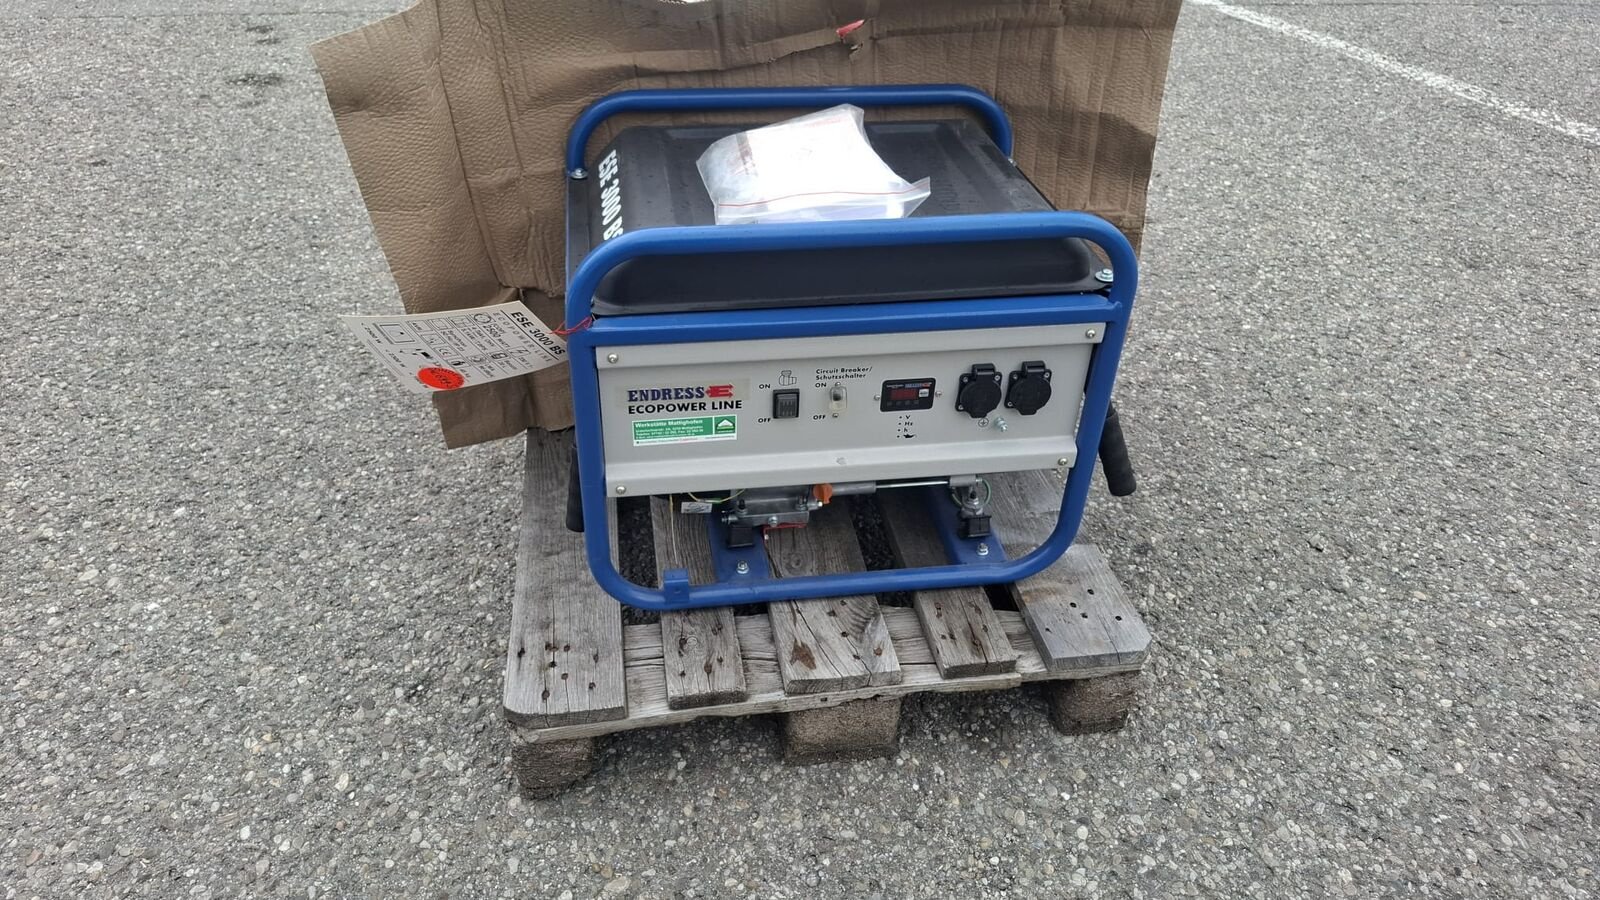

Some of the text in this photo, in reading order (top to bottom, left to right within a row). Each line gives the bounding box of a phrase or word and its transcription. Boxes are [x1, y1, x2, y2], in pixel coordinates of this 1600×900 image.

[598, 149, 618, 189] ESE
[600, 178, 622, 226] 3000
[510, 311, 566, 355] ESE 3000 BS
[815, 367, 838, 375] Circuit
[815, 373, 866, 381] Schutzschalter
[627, 386, 705, 402] ENDRESS
[628, 400, 743, 414] ECOPOWER LINE
